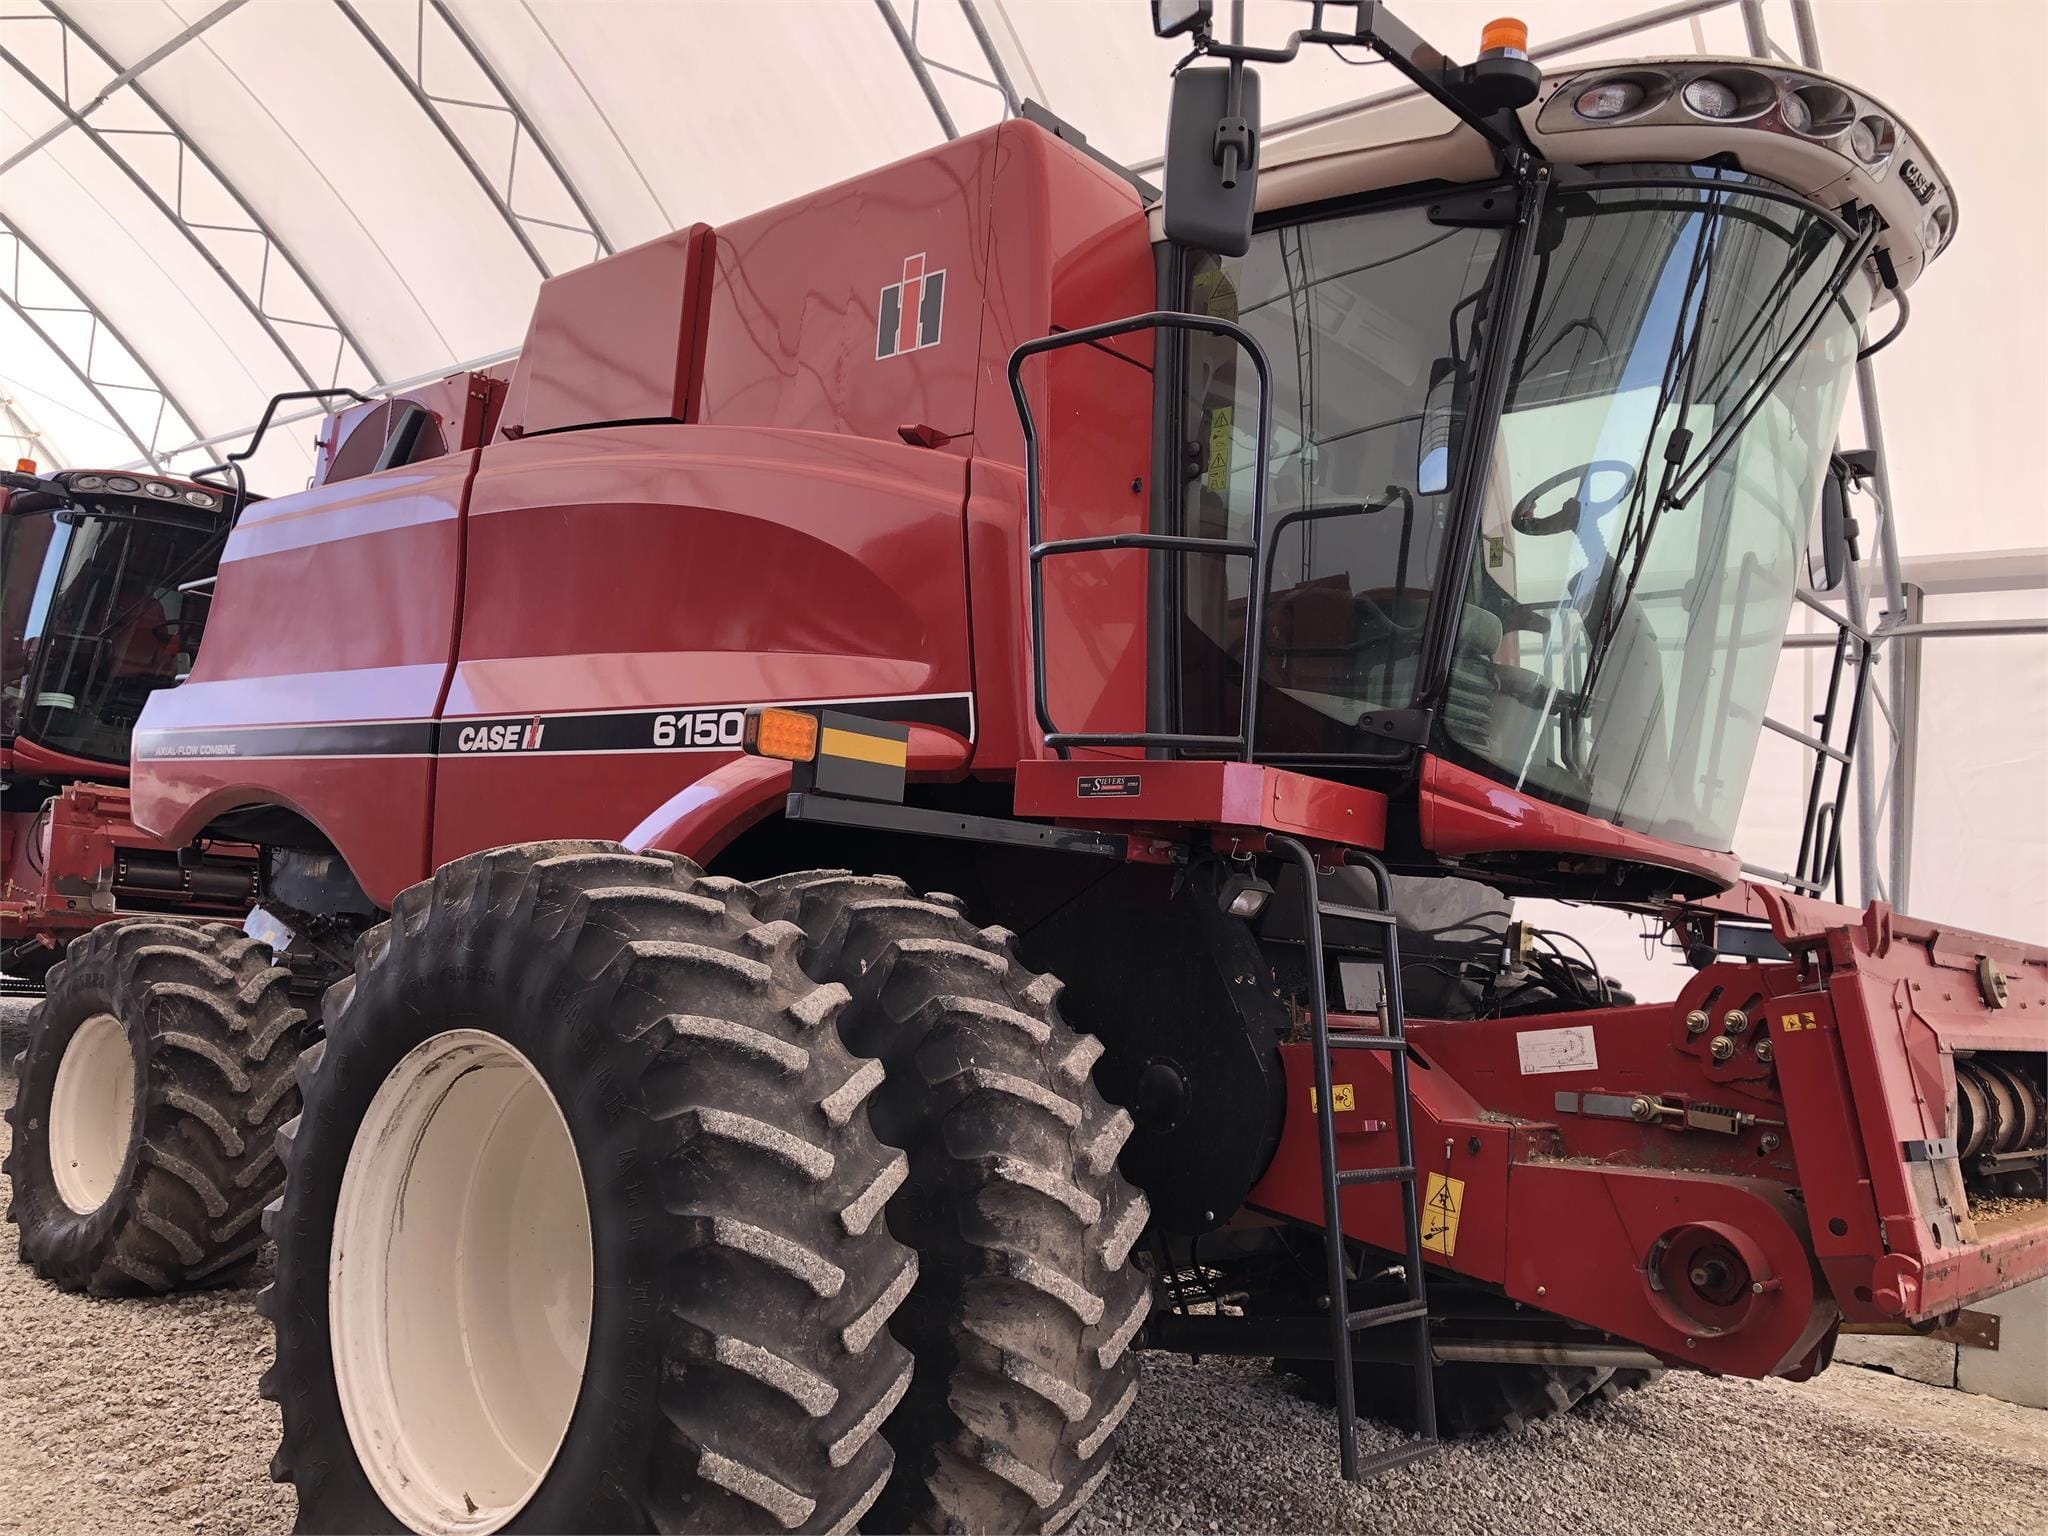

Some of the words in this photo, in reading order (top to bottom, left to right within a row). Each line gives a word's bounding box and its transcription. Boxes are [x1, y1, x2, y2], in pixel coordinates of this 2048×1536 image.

[1906, 163, 1931, 195] CASE
[458, 725, 521, 751] CASE
[653, 711, 744, 746] 6150
[155, 745, 199, 756] AXIAL-FLOW
[200, 744, 236, 755] COMBINE
